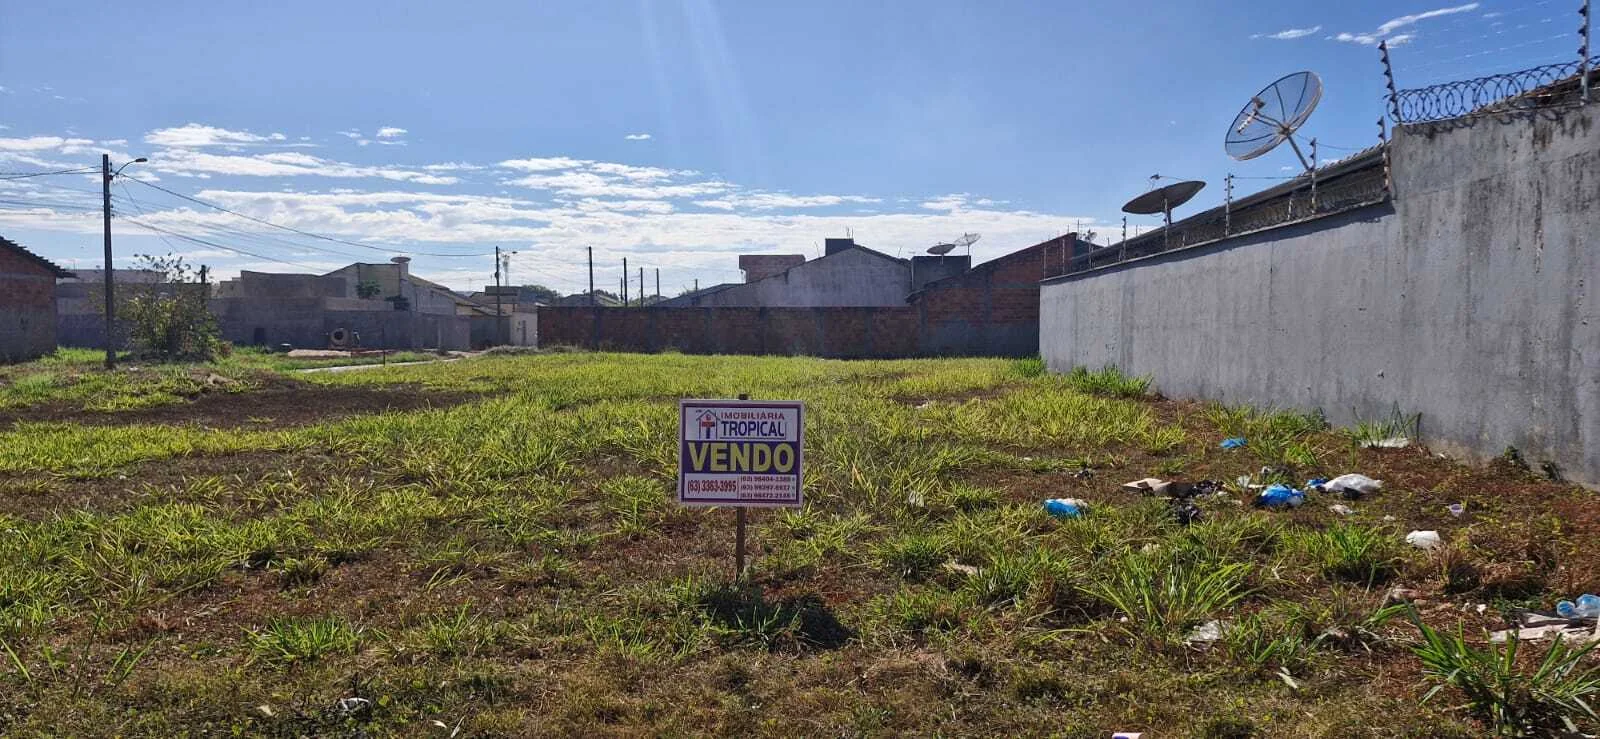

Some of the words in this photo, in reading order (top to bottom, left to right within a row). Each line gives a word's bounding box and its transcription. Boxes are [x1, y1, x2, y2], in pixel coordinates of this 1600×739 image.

[720, 421, 785, 437] TROPICAL
[687, 442, 795, 473] VENDO
[687, 479, 701, 494] (63)
[701, 480, 737, 492] 3363-3995
